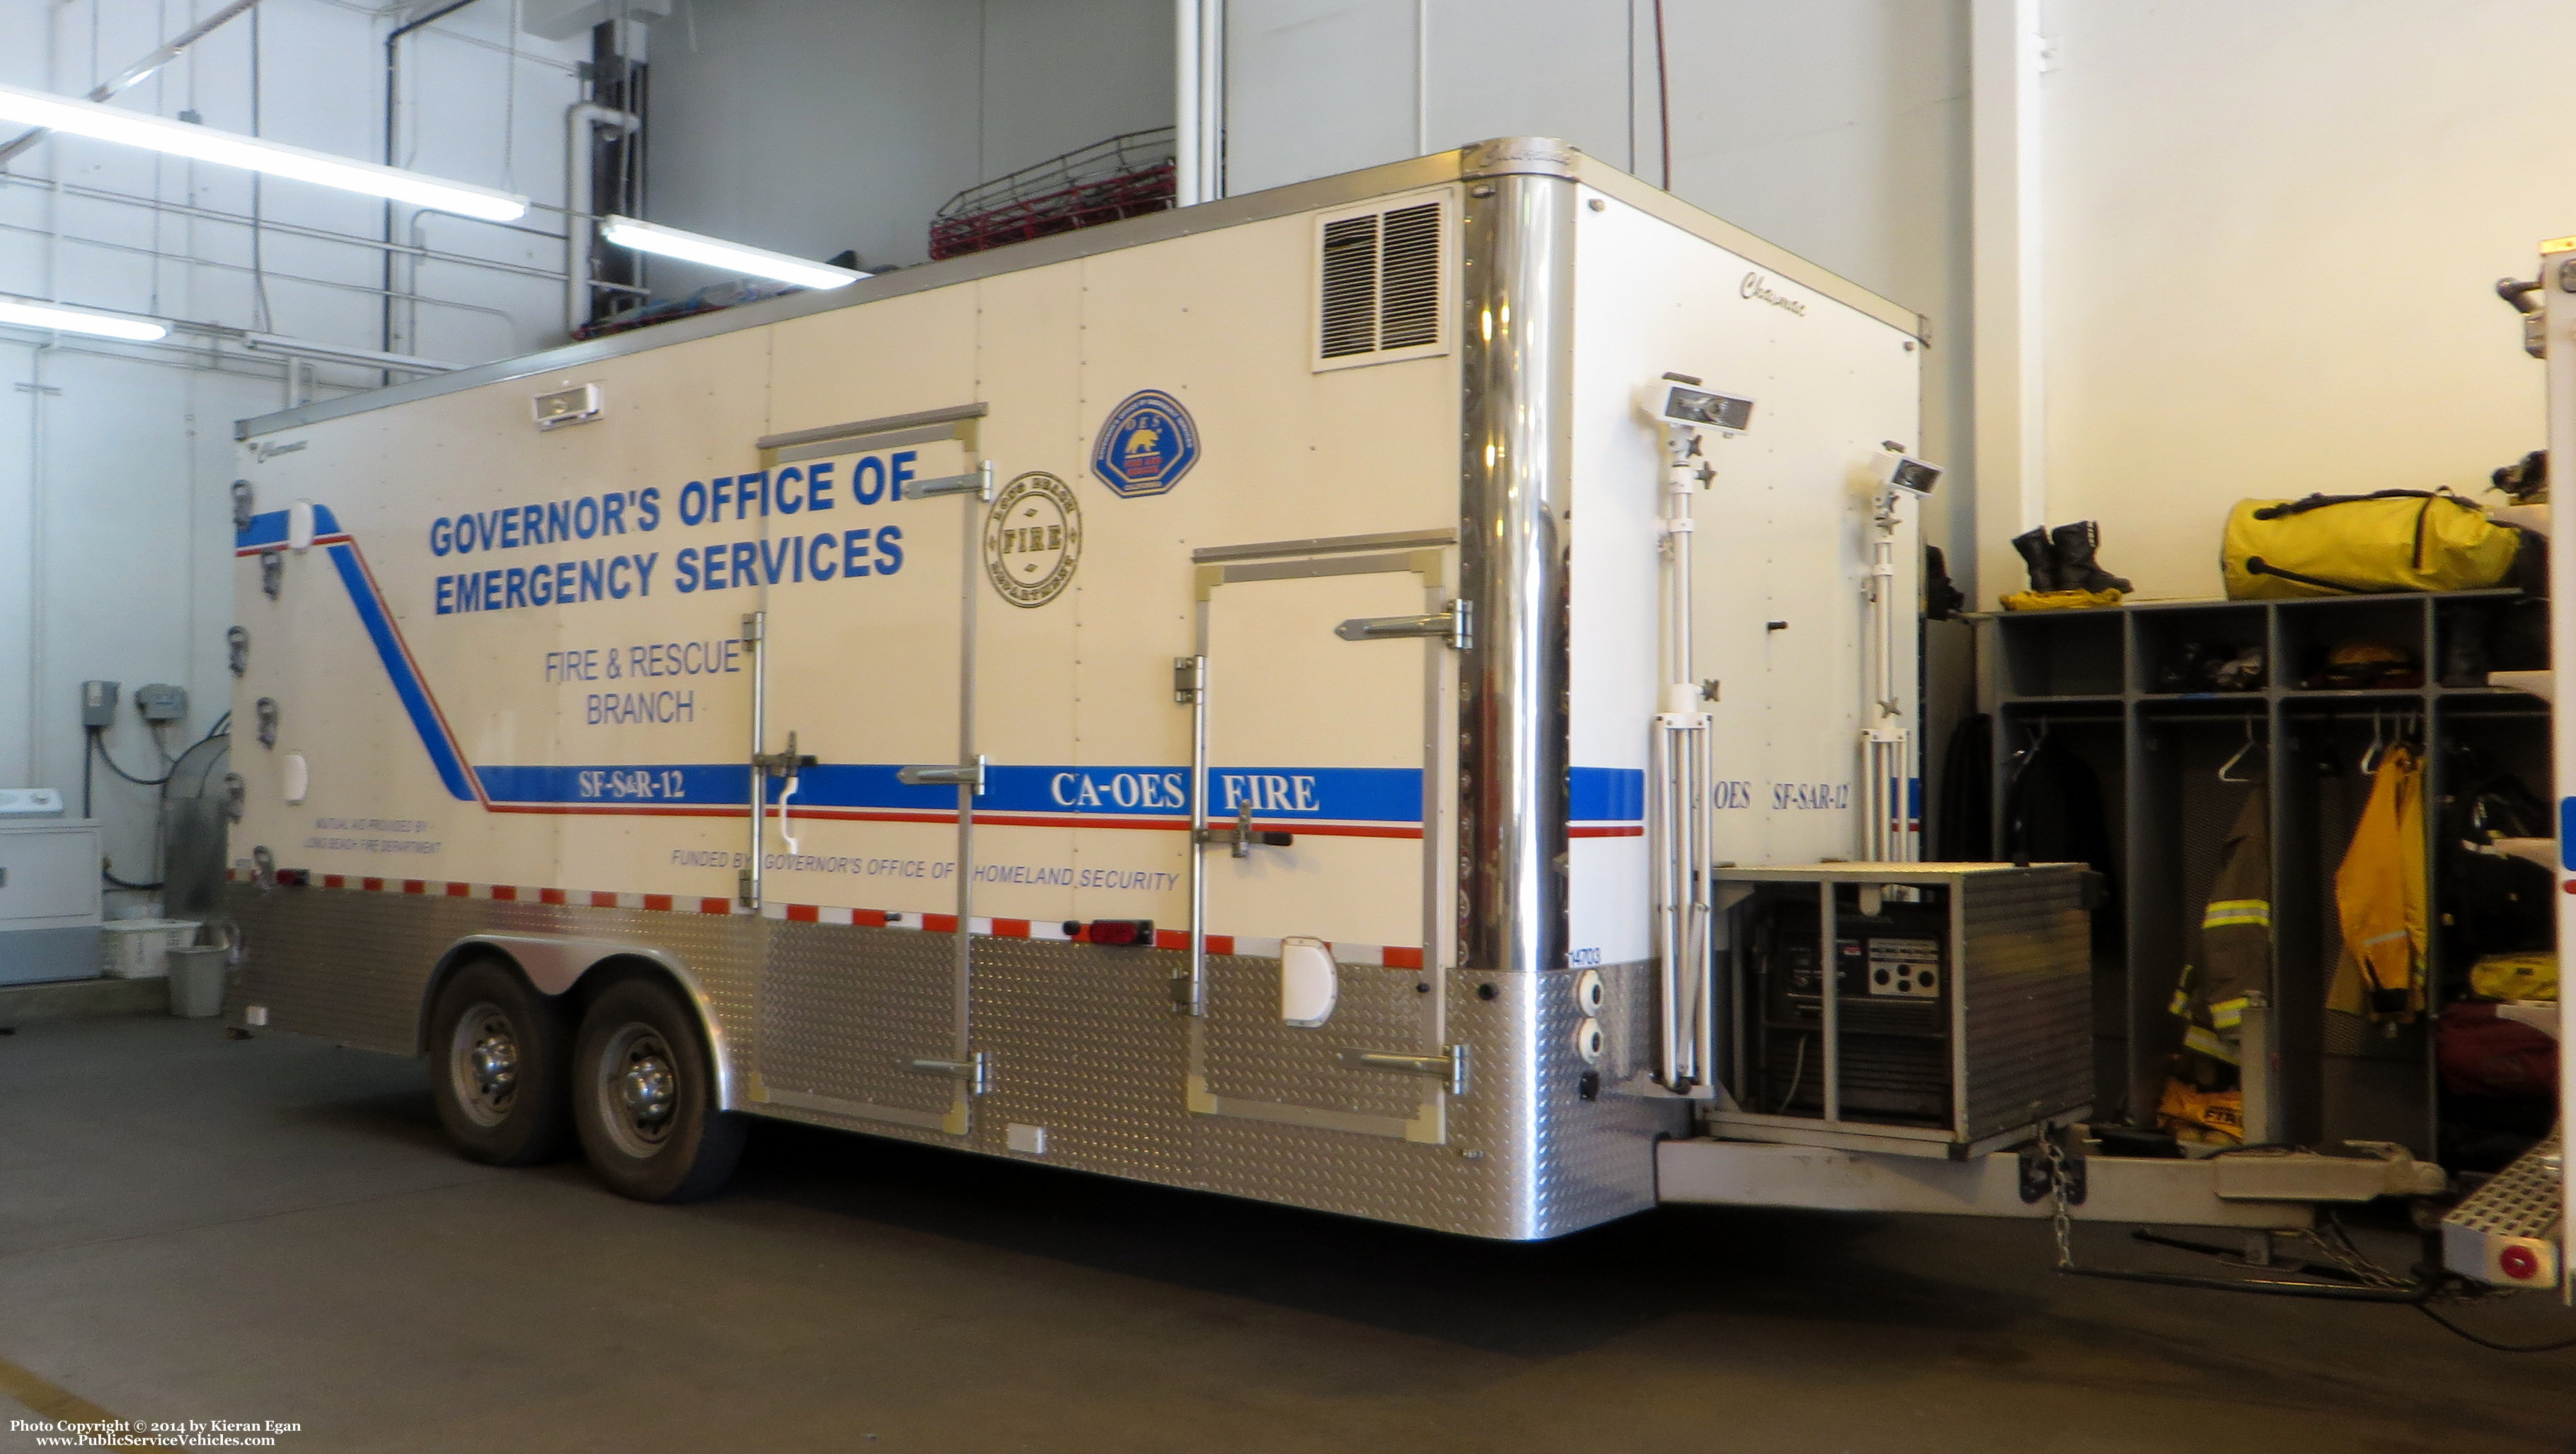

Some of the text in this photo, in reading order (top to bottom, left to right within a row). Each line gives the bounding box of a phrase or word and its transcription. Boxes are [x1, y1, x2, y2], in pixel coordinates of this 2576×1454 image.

[430, 450, 917, 556] GOVERNOR'S OFFICE OF
[1003, 525, 1062, 554] FIRE
[435, 525, 903, 615] EMERGENCY SERVICES
[546, 639, 740, 682] FIRE & RESCUE
[587, 690, 694, 725] BRANCH
[577, 770, 686, 798] SF-S&R-12
[1052, 772, 1320, 811] CA-OES FIRE
[1771, 784, 1848, 809] SF-SAR-12
[672, 849, 1180, 891] FUNDED BY GOVERNOR'S OFFICE OF HOMELAND SECURITY
